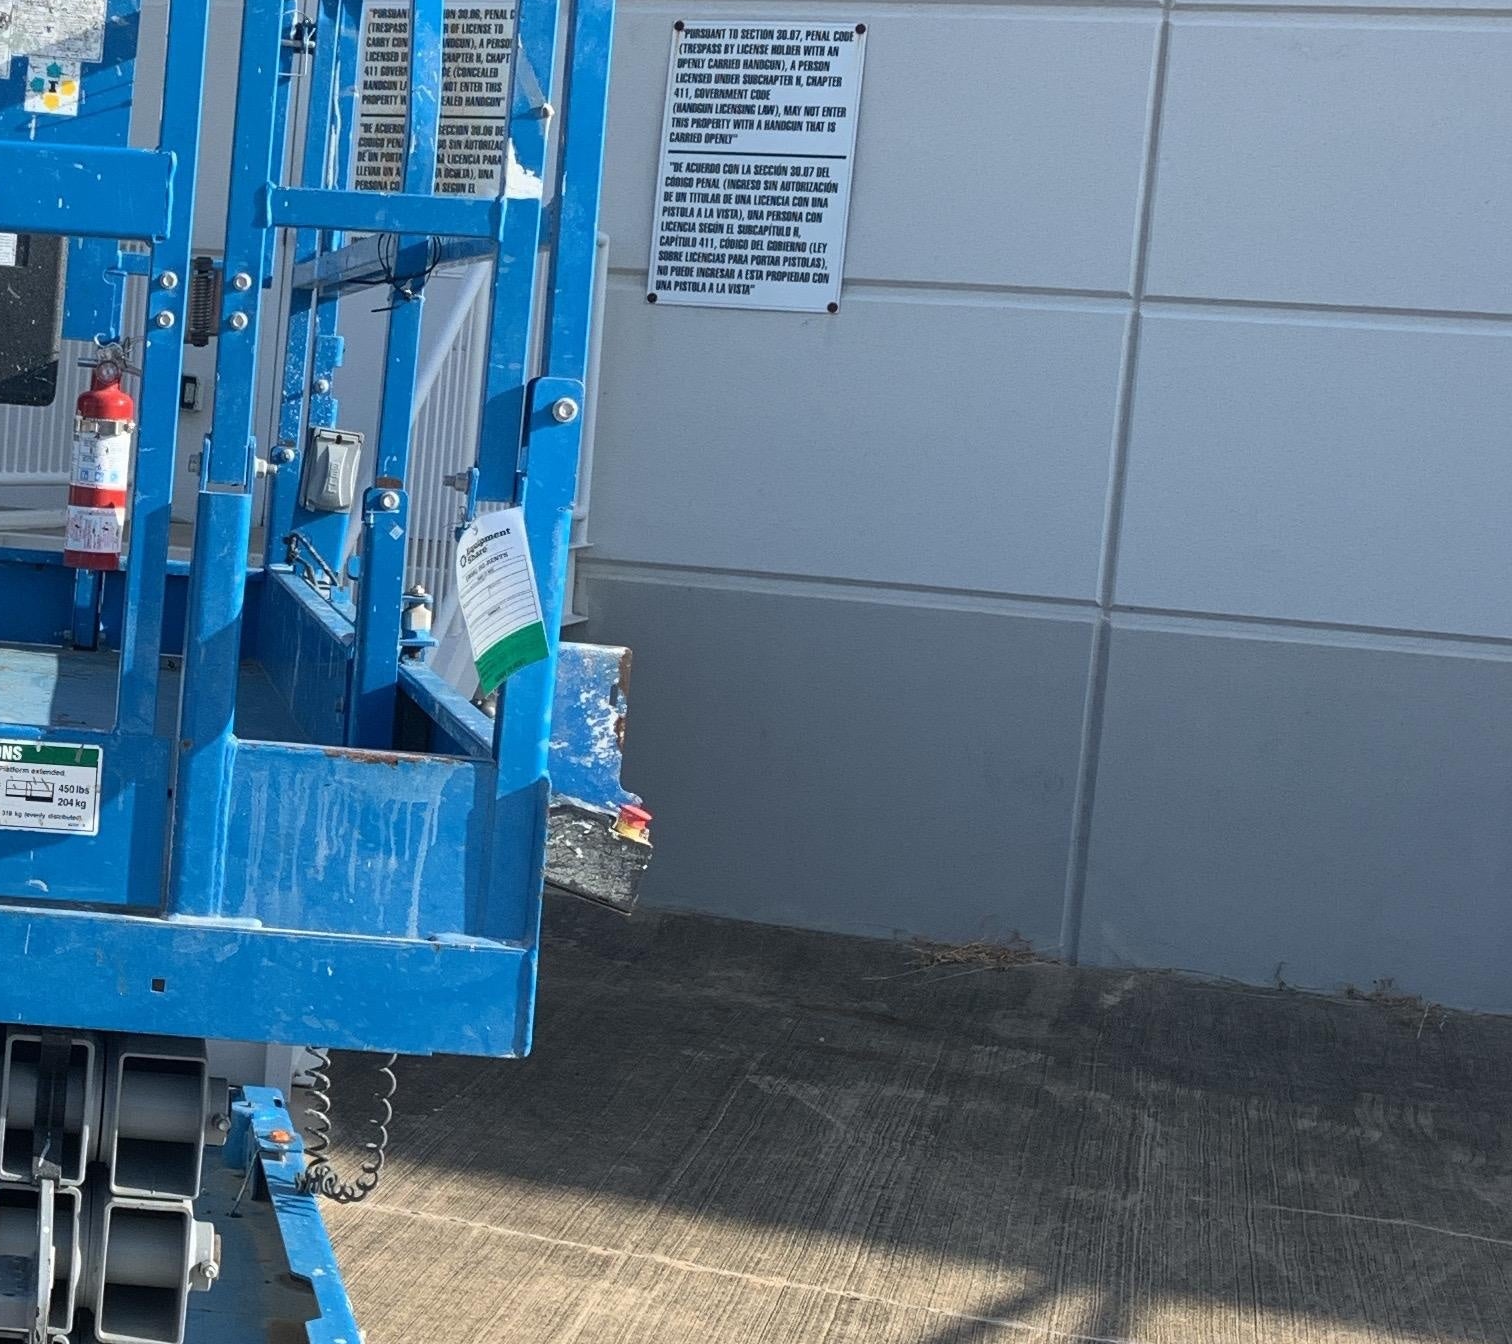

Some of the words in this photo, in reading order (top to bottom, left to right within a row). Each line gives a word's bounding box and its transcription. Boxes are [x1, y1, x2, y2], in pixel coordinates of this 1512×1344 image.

[484, 9, 507, 20] PENAL
[461, 24, 491, 34] LICENSE
[494, 25, 504, 34] TO
[729, 29, 738, 40] TO
[741, 29, 774, 40] SECTION
[805, 30, 830, 41] PENAL
[833, 31, 854, 42] CODE
[366, 37, 390, 48] CARRY
[365, 51, 399, 62] LICENSED
[679, 43, 722, 55] (TRESPASS
[724, 44, 735, 54] BY
[737, 44, 768, 55] LICENSE
[771, 45, 801, 56] HOLDER
[803, 46, 825, 56] WITH
[827, 46, 839, 57] AN
[677, 58, 706, 69] OPENLY
[708, 58, 740, 69] CARRIED
[742, 59, 787, 72] HANDGUN),
[798, 60, 830, 72] PERSON
[364, 66, 377, 77] 411
[453, 68, 498, 78] (CONCEALED
[363, 80, 397, 91] HANDGUN
[460, 82, 483, 93] ENTER
[485, 83, 502, 93] THIS
[675, 73, 712, 84] LICENSED
[714, 73, 740, 84] UNDER
[743, 74, 793, 86] SUBCHAPTER
[806, 76, 842, 87] CHAPTER
[361, 95, 398, 106] PROPERTY
[674, 88, 692, 100] 411,
[694, 88, 749, 99] GOVERNMENT
[750, 89, 771, 100] CODE
[673, 102, 713, 114] (HANDGUN
[715, 103, 756, 115] LICENSING
[758, 105, 781, 117] LAW),
[784, 105, 802, 116] MAY
[804, 106, 820, 117] NOT
[822, 106, 847, 118] ENTER
[672, 117, 689, 128] THIS
[691, 118, 731, 129] PROPERTY
[733, 119, 754, 130] WITH
[764, 120, 803, 131] HANDGUN
[806, 121, 825, 132] THAT
[827, 122, 836, 133] IS
[669, 132, 702, 143] CARRIED
[704, 133, 738, 144] OPENLY"
[448, 140, 462, 150] SIN
[368, 152, 378, 162] UN
[447, 154, 480, 165] LICENCIA
[356, 166, 381, 176] LLEVAR
[383, 167, 393, 176] UN
[478, 169, 494, 179] UNA
[670, 162, 683, 173] "DE
[685, 162, 721, 174] ACUERDO
[723, 163, 740, 175] CON
[742, 164, 751, 175] LA
[754, 163, 788, 176] SECCIÓN
[790, 166, 815, 177] 30.07
[816, 167, 830, 178] DEL
[355, 180, 388, 191] PERSONA
[696, 177, 720, 189] PENAL
[723, 178, 761, 190] (INGRESO
[764, 180, 778, 191] SIN
[780, 180, 839, 193] AUTORIZACIÓN
[664, 191, 673, 202] DE
[675, 192, 687, 202] UN
[689, 192, 721, 204] TITULAR
[723, 193, 732, 204] DE
[735, 194, 751, 205] UNA
[754, 195, 789, 206] LICENCIA
[792, 196, 809, 207] CON
[811, 197, 828, 208] UNA
[662, 206, 694, 217] PISTOLA
[704, 207, 714, 218] LA
[716, 208, 744, 221] VISTA),
[748, 210, 764, 221] UNA
[766, 210, 803, 222] PERSONA
[805, 212, 823, 223] CON
[661, 221, 696, 233] LICENCIA
[726, 224, 734, 234] EL
[737, 223, 791, 237] SUBCAPÍTULO
[660, 234, 697, 248] CAPÍTULO
[699, 237, 718, 250] 411,
[750, 239, 764, 251] DEL
[767, 240, 807, 253] GOBIERNO
[809, 242, 827, 254] (LEY
[658, 250, 683, 262] SOBRE
[685, 252, 726, 264] LICENCIAS
[728, 254, 748, 265] PARA
[750, 255, 780, 266] PORTAR
[782, 256, 827, 270] PISTOLAS),
[657, 265, 668, 276] NO
[670, 266, 694, 277] PUEDE
[696, 267, 735, 279] INGRESAR
[745, 269, 763, 281] ESTA
[766, 270, 810, 283] PROPIEDAD
[812, 272, 830, 284] CON
[656, 279, 672, 291] UNA
[674, 281, 706, 292] PISTOLA
[716, 283, 725, 293] LA
[728, 284, 755, 295] VISTA"
[466, 528, 510, 555] Equipment
[467, 546, 487, 564] Share
[58, 784, 74, 794] 450
[76, 785, 89, 794] lbs
[57, 797, 74, 807] 204
[75, 798, 87, 809] kg
